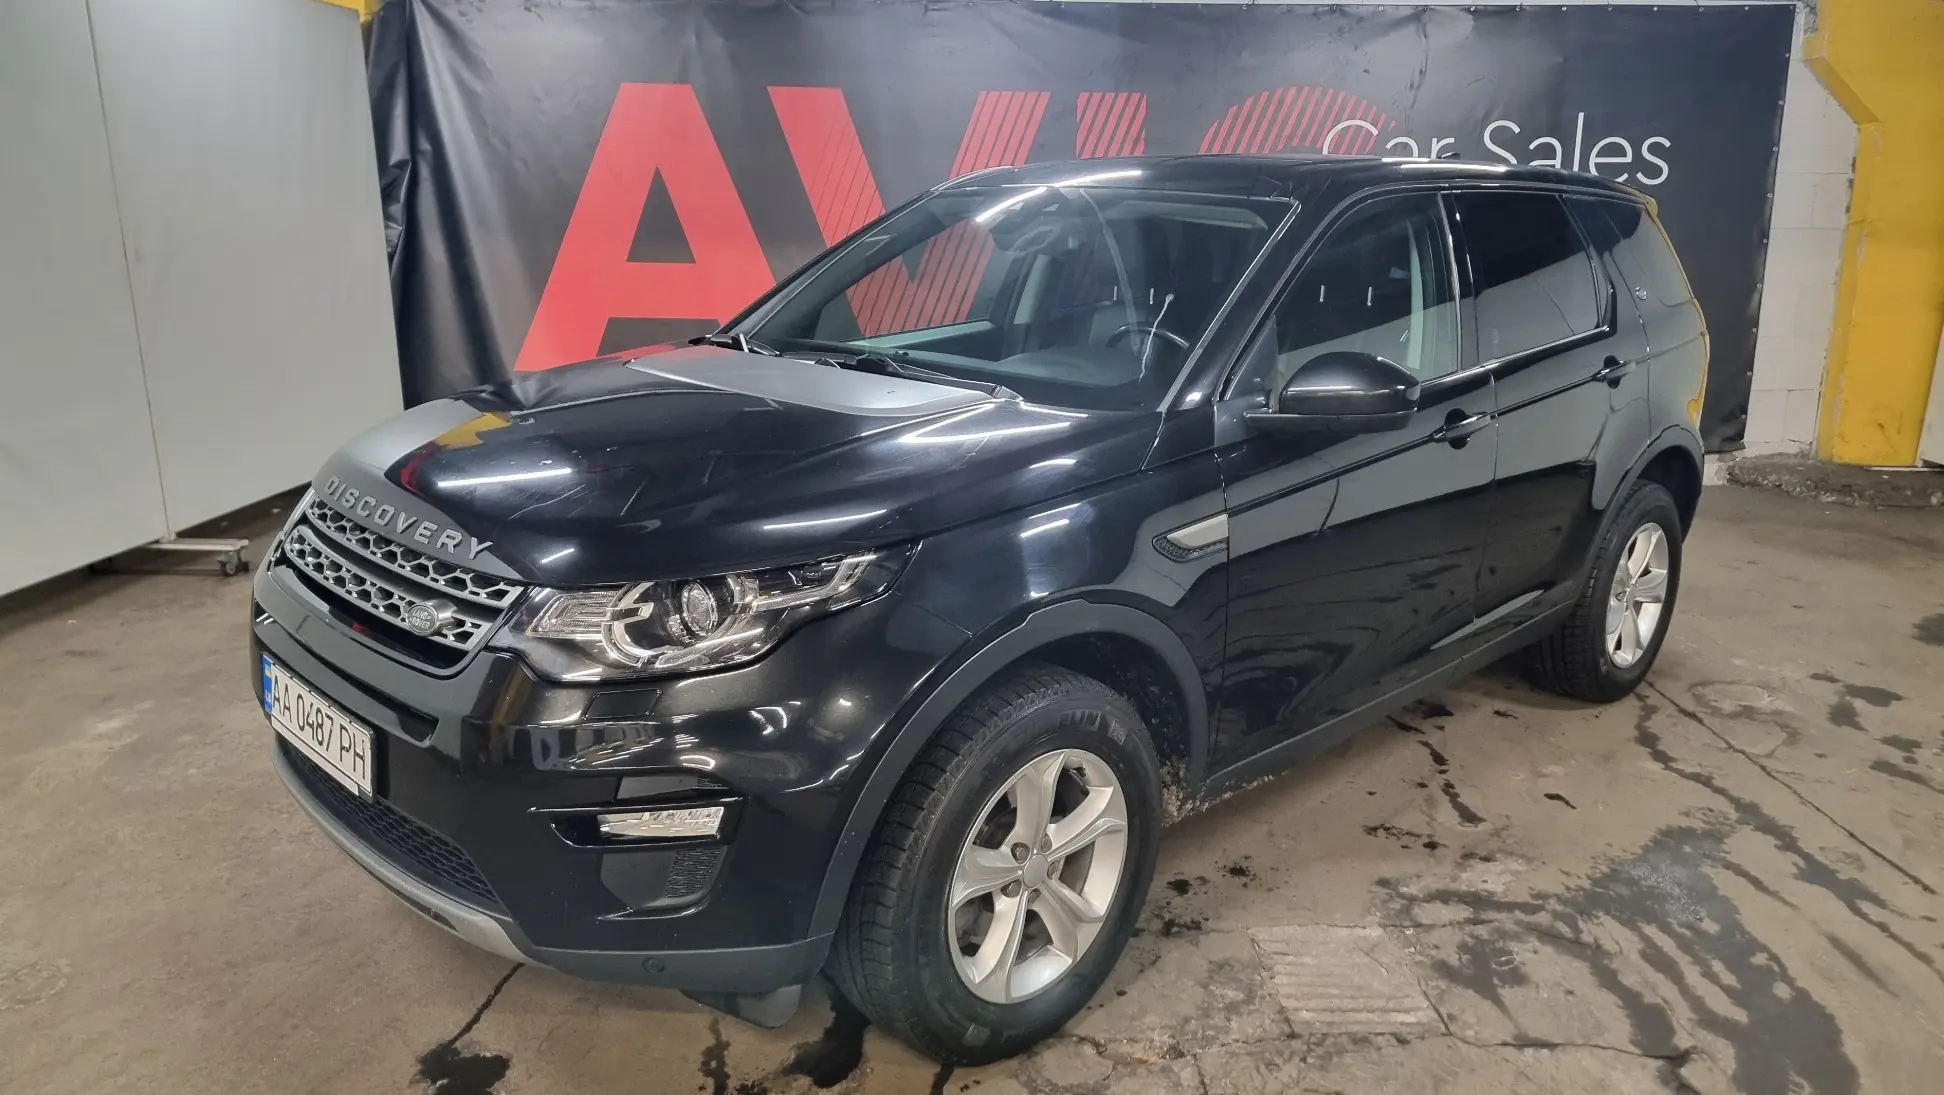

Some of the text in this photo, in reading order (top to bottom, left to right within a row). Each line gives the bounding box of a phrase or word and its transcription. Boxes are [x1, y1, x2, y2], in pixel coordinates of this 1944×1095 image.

[1484, 112, 1672, 185] Sales
[513, 82, 1396, 372] AV
[324, 475, 494, 560] DISCOVERY
[410, 616, 431, 630] ROVER
[411, 608, 429, 620] LAND
[272, 673, 366, 781] AA 0487 PH
